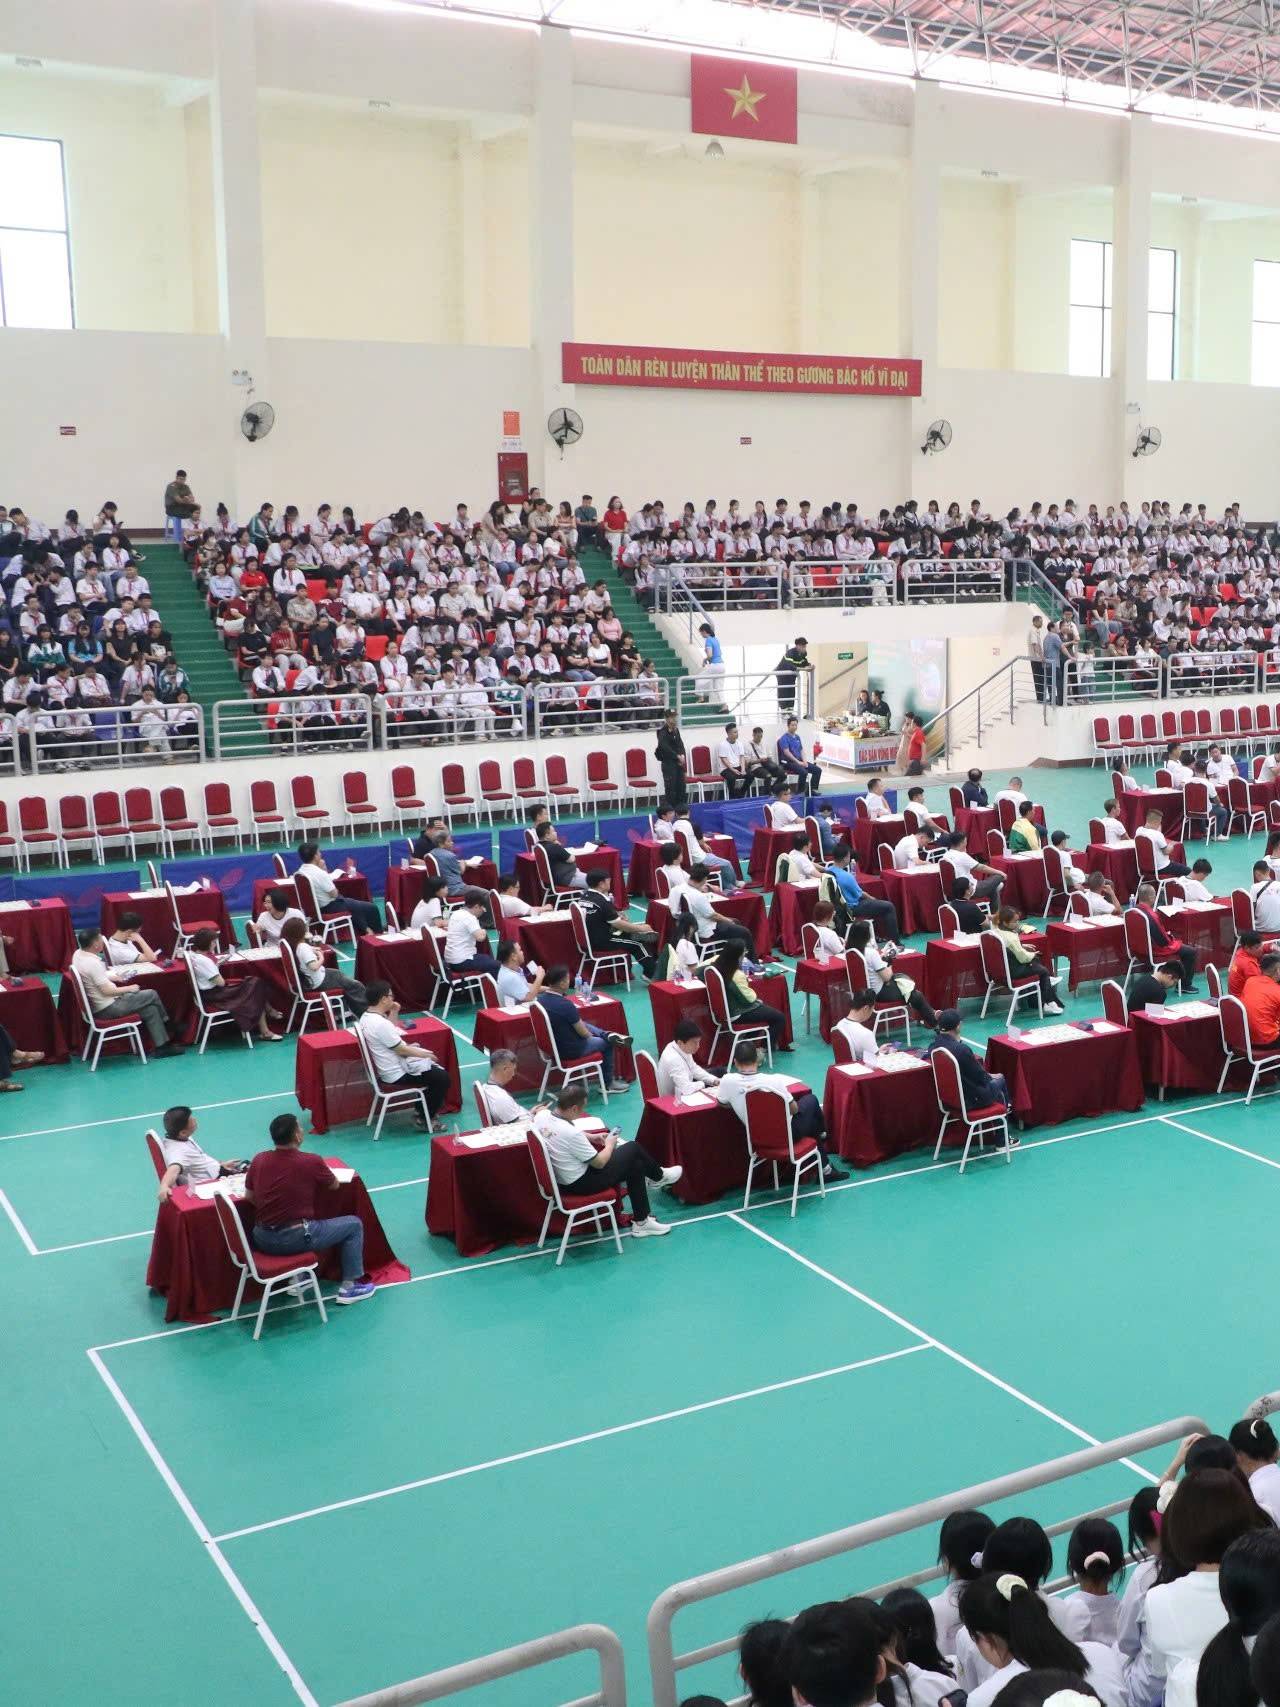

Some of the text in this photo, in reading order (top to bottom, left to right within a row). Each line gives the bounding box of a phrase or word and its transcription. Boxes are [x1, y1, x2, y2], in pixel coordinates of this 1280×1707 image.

[581, 355, 907, 390] TOÀN DÂN RÈN LUYỆN THÂN THỂ THEO GƯƠNG BÁC HỒ VĨ ĐẠI
